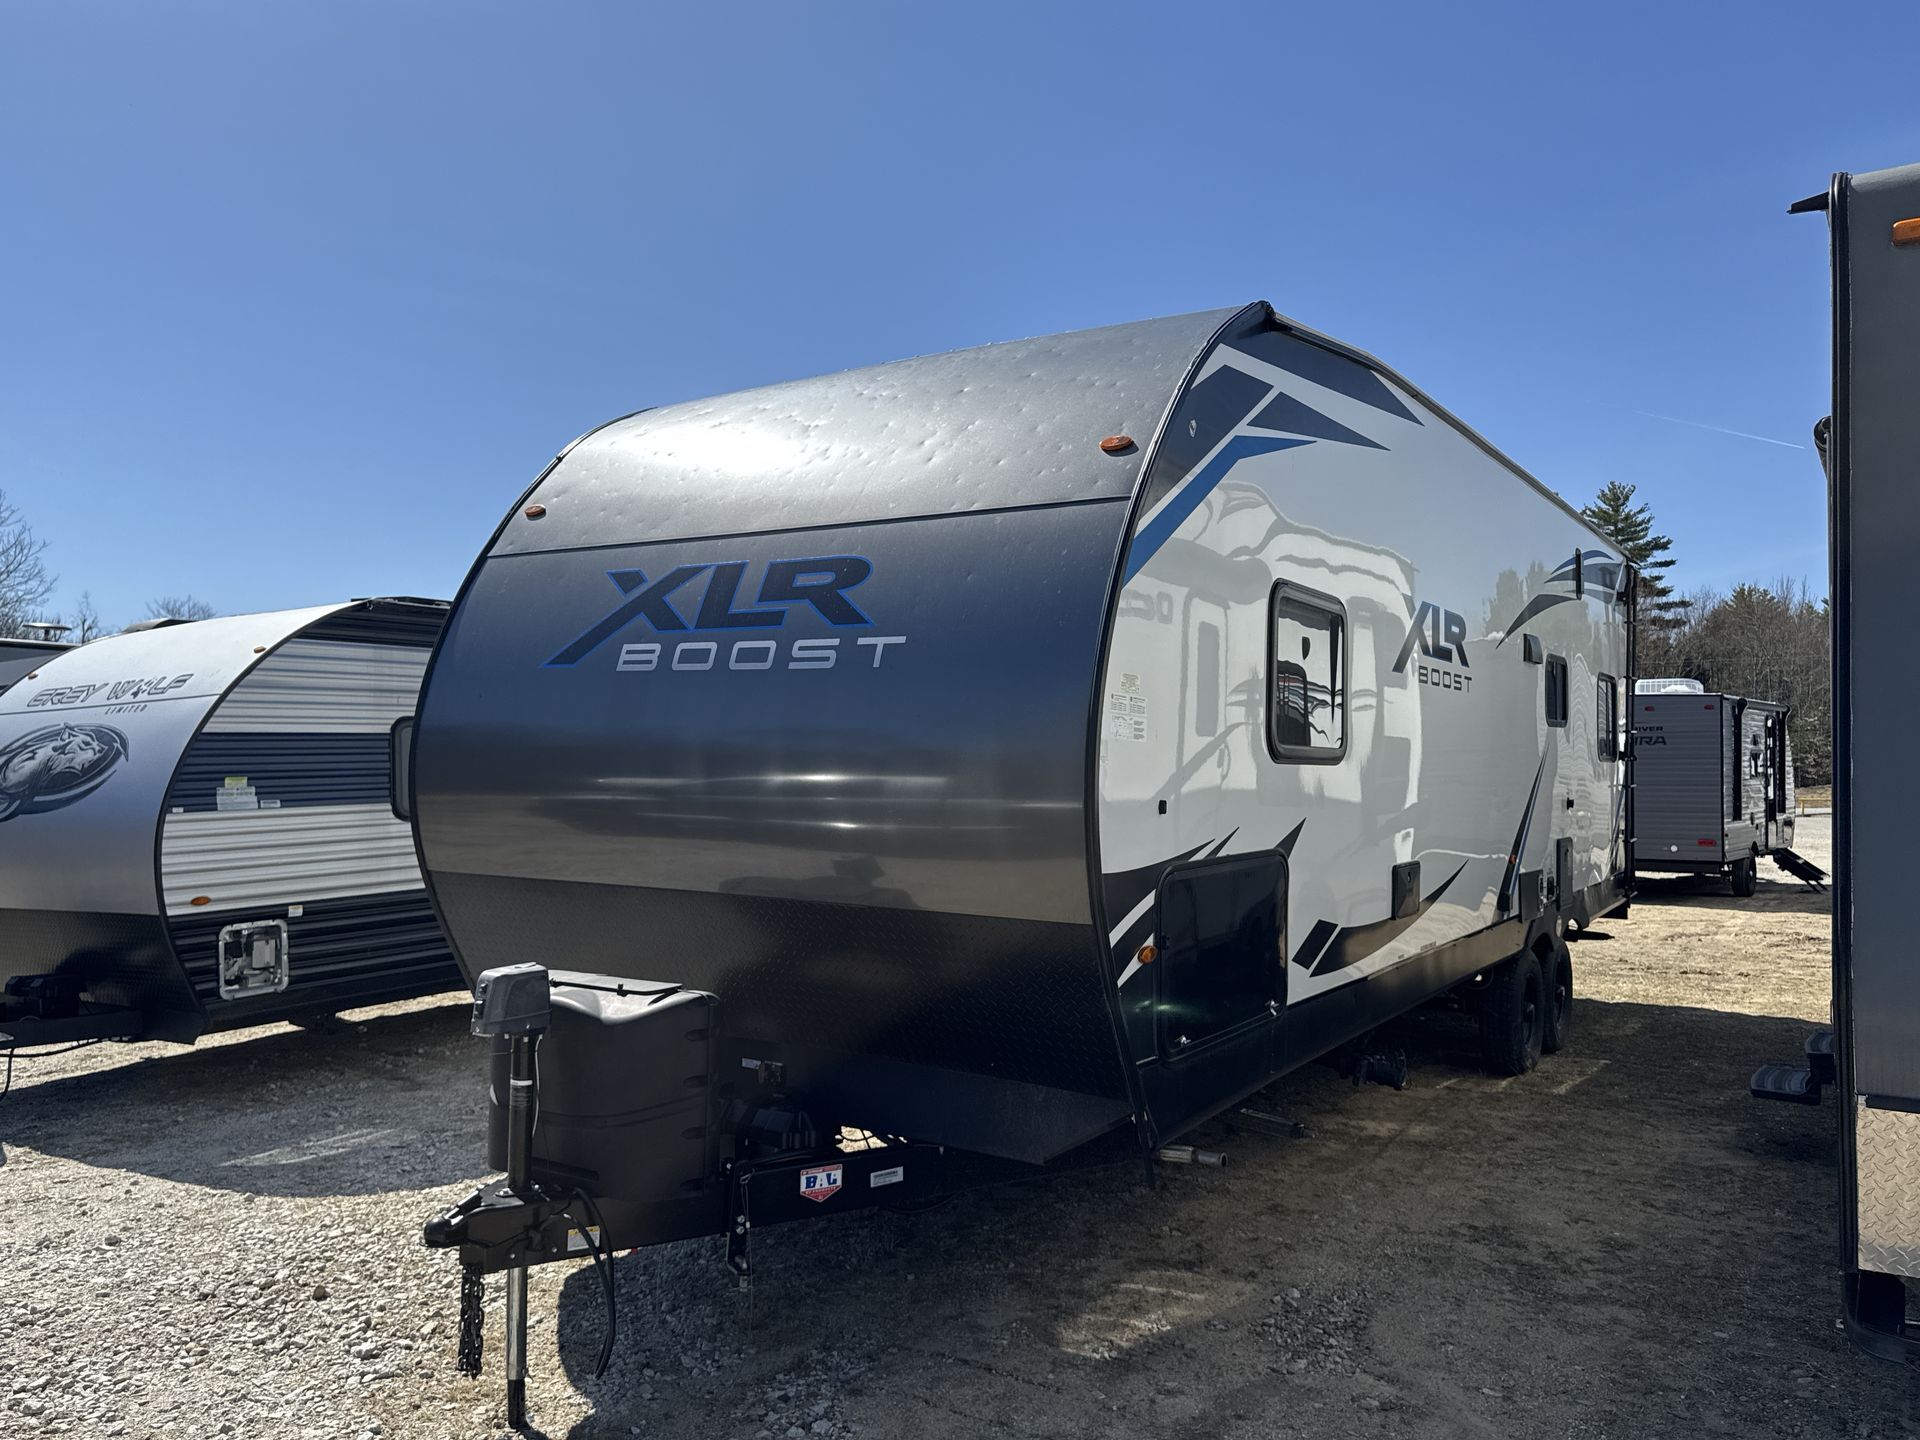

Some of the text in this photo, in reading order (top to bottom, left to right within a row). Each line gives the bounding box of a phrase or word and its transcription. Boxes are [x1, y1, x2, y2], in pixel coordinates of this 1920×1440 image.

[538, 554, 876, 668] XLR
[1392, 592, 1470, 674] XLR
[616, 635, 907, 672] BOOST
[1418, 664, 1473, 693] BOOST
[104, 703, 148, 715] LIMITED
